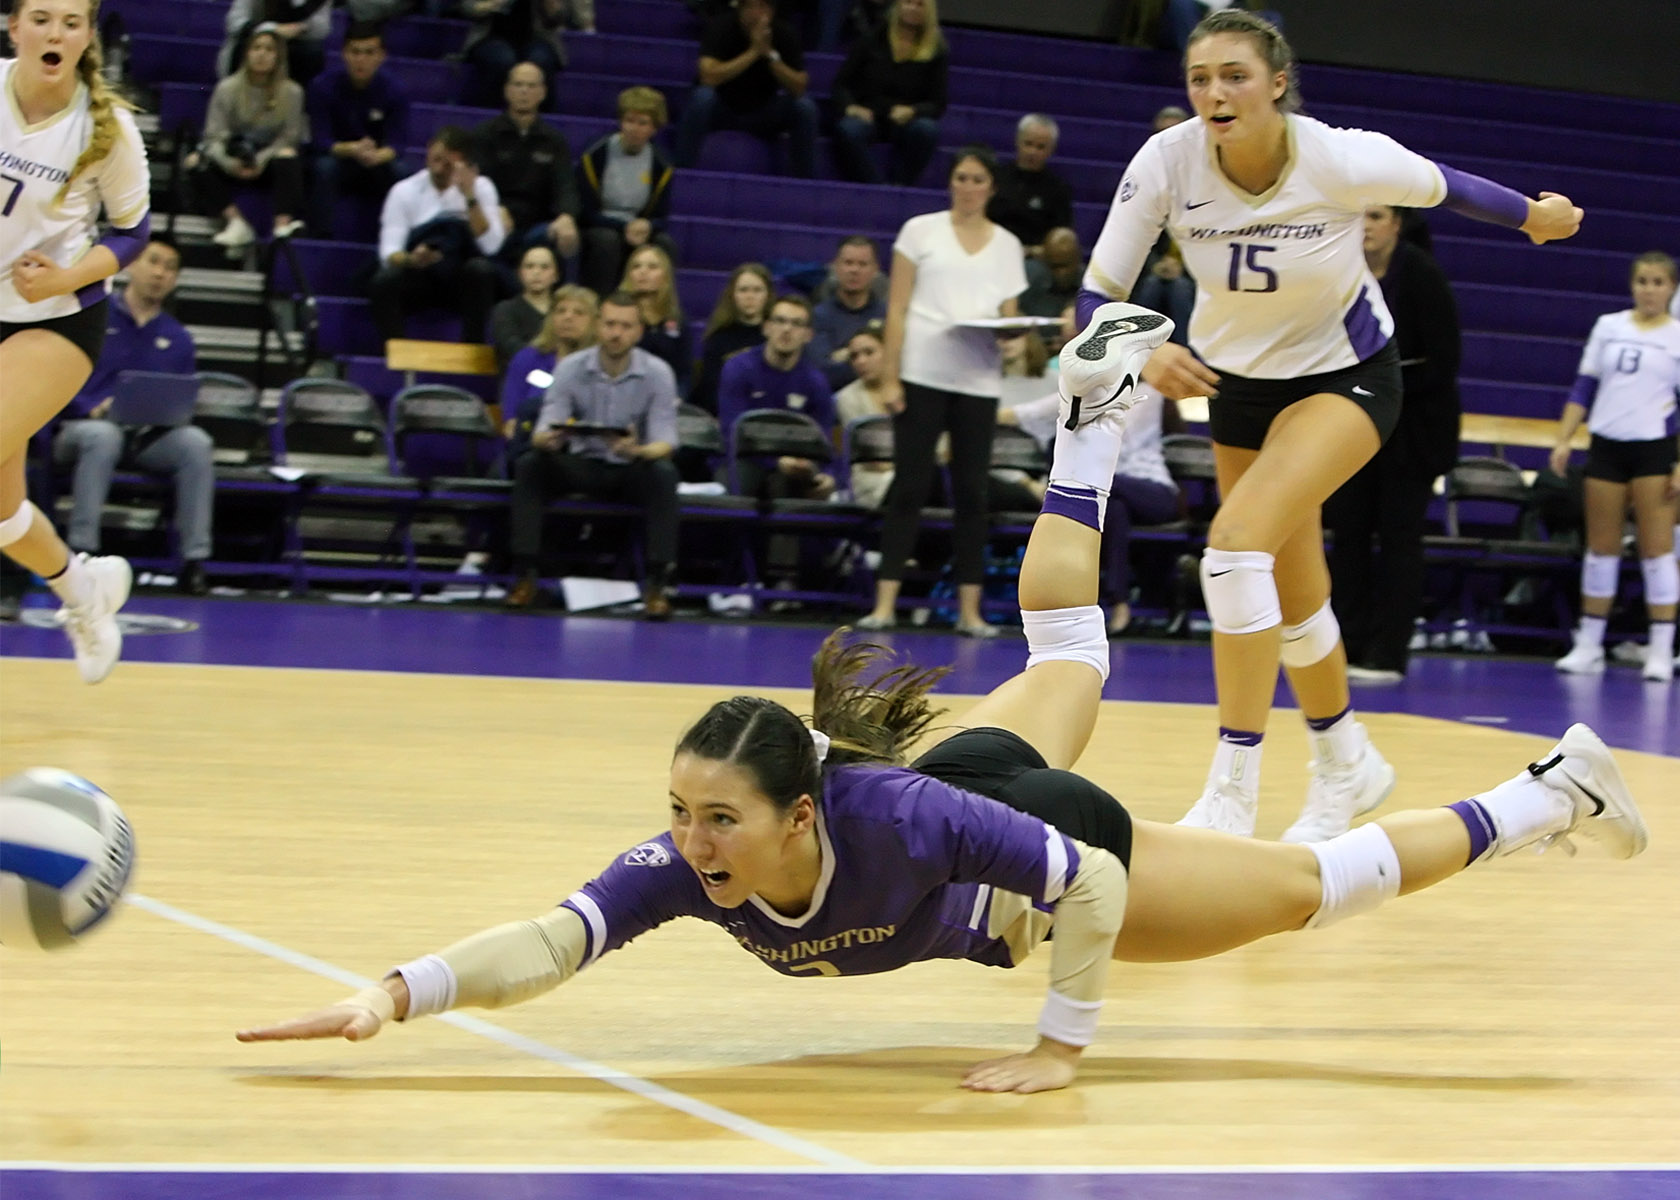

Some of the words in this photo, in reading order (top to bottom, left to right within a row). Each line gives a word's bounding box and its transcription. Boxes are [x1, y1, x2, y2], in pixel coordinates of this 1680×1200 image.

[0, 173, 25, 217] 7
[1190, 222, 1328, 240] WINGTON
[1228, 242, 1278, 293] 15
[737, 924, 896, 963] ASHINGTON
